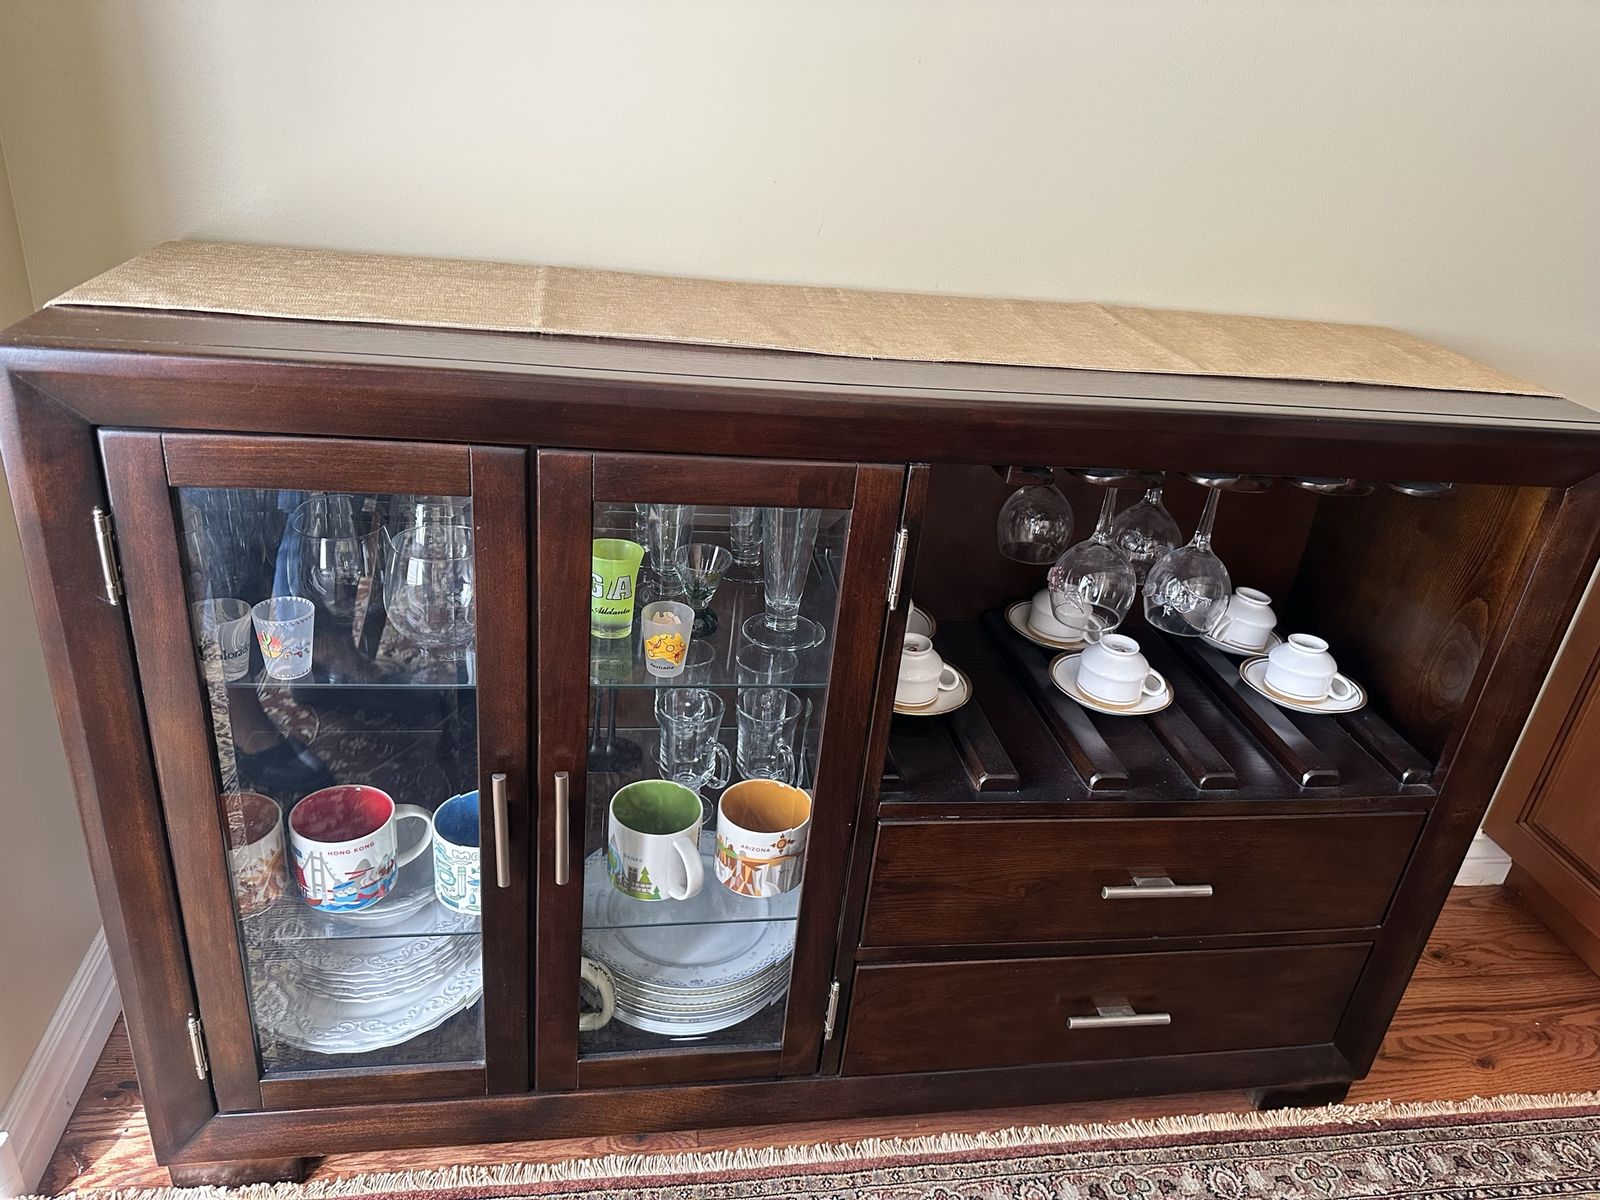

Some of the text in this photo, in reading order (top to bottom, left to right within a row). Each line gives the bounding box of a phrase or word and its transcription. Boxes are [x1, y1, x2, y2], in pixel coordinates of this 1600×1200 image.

[327, 841, 375, 857] HONG KONG
[740, 843, 771, 853] ARIZONA
